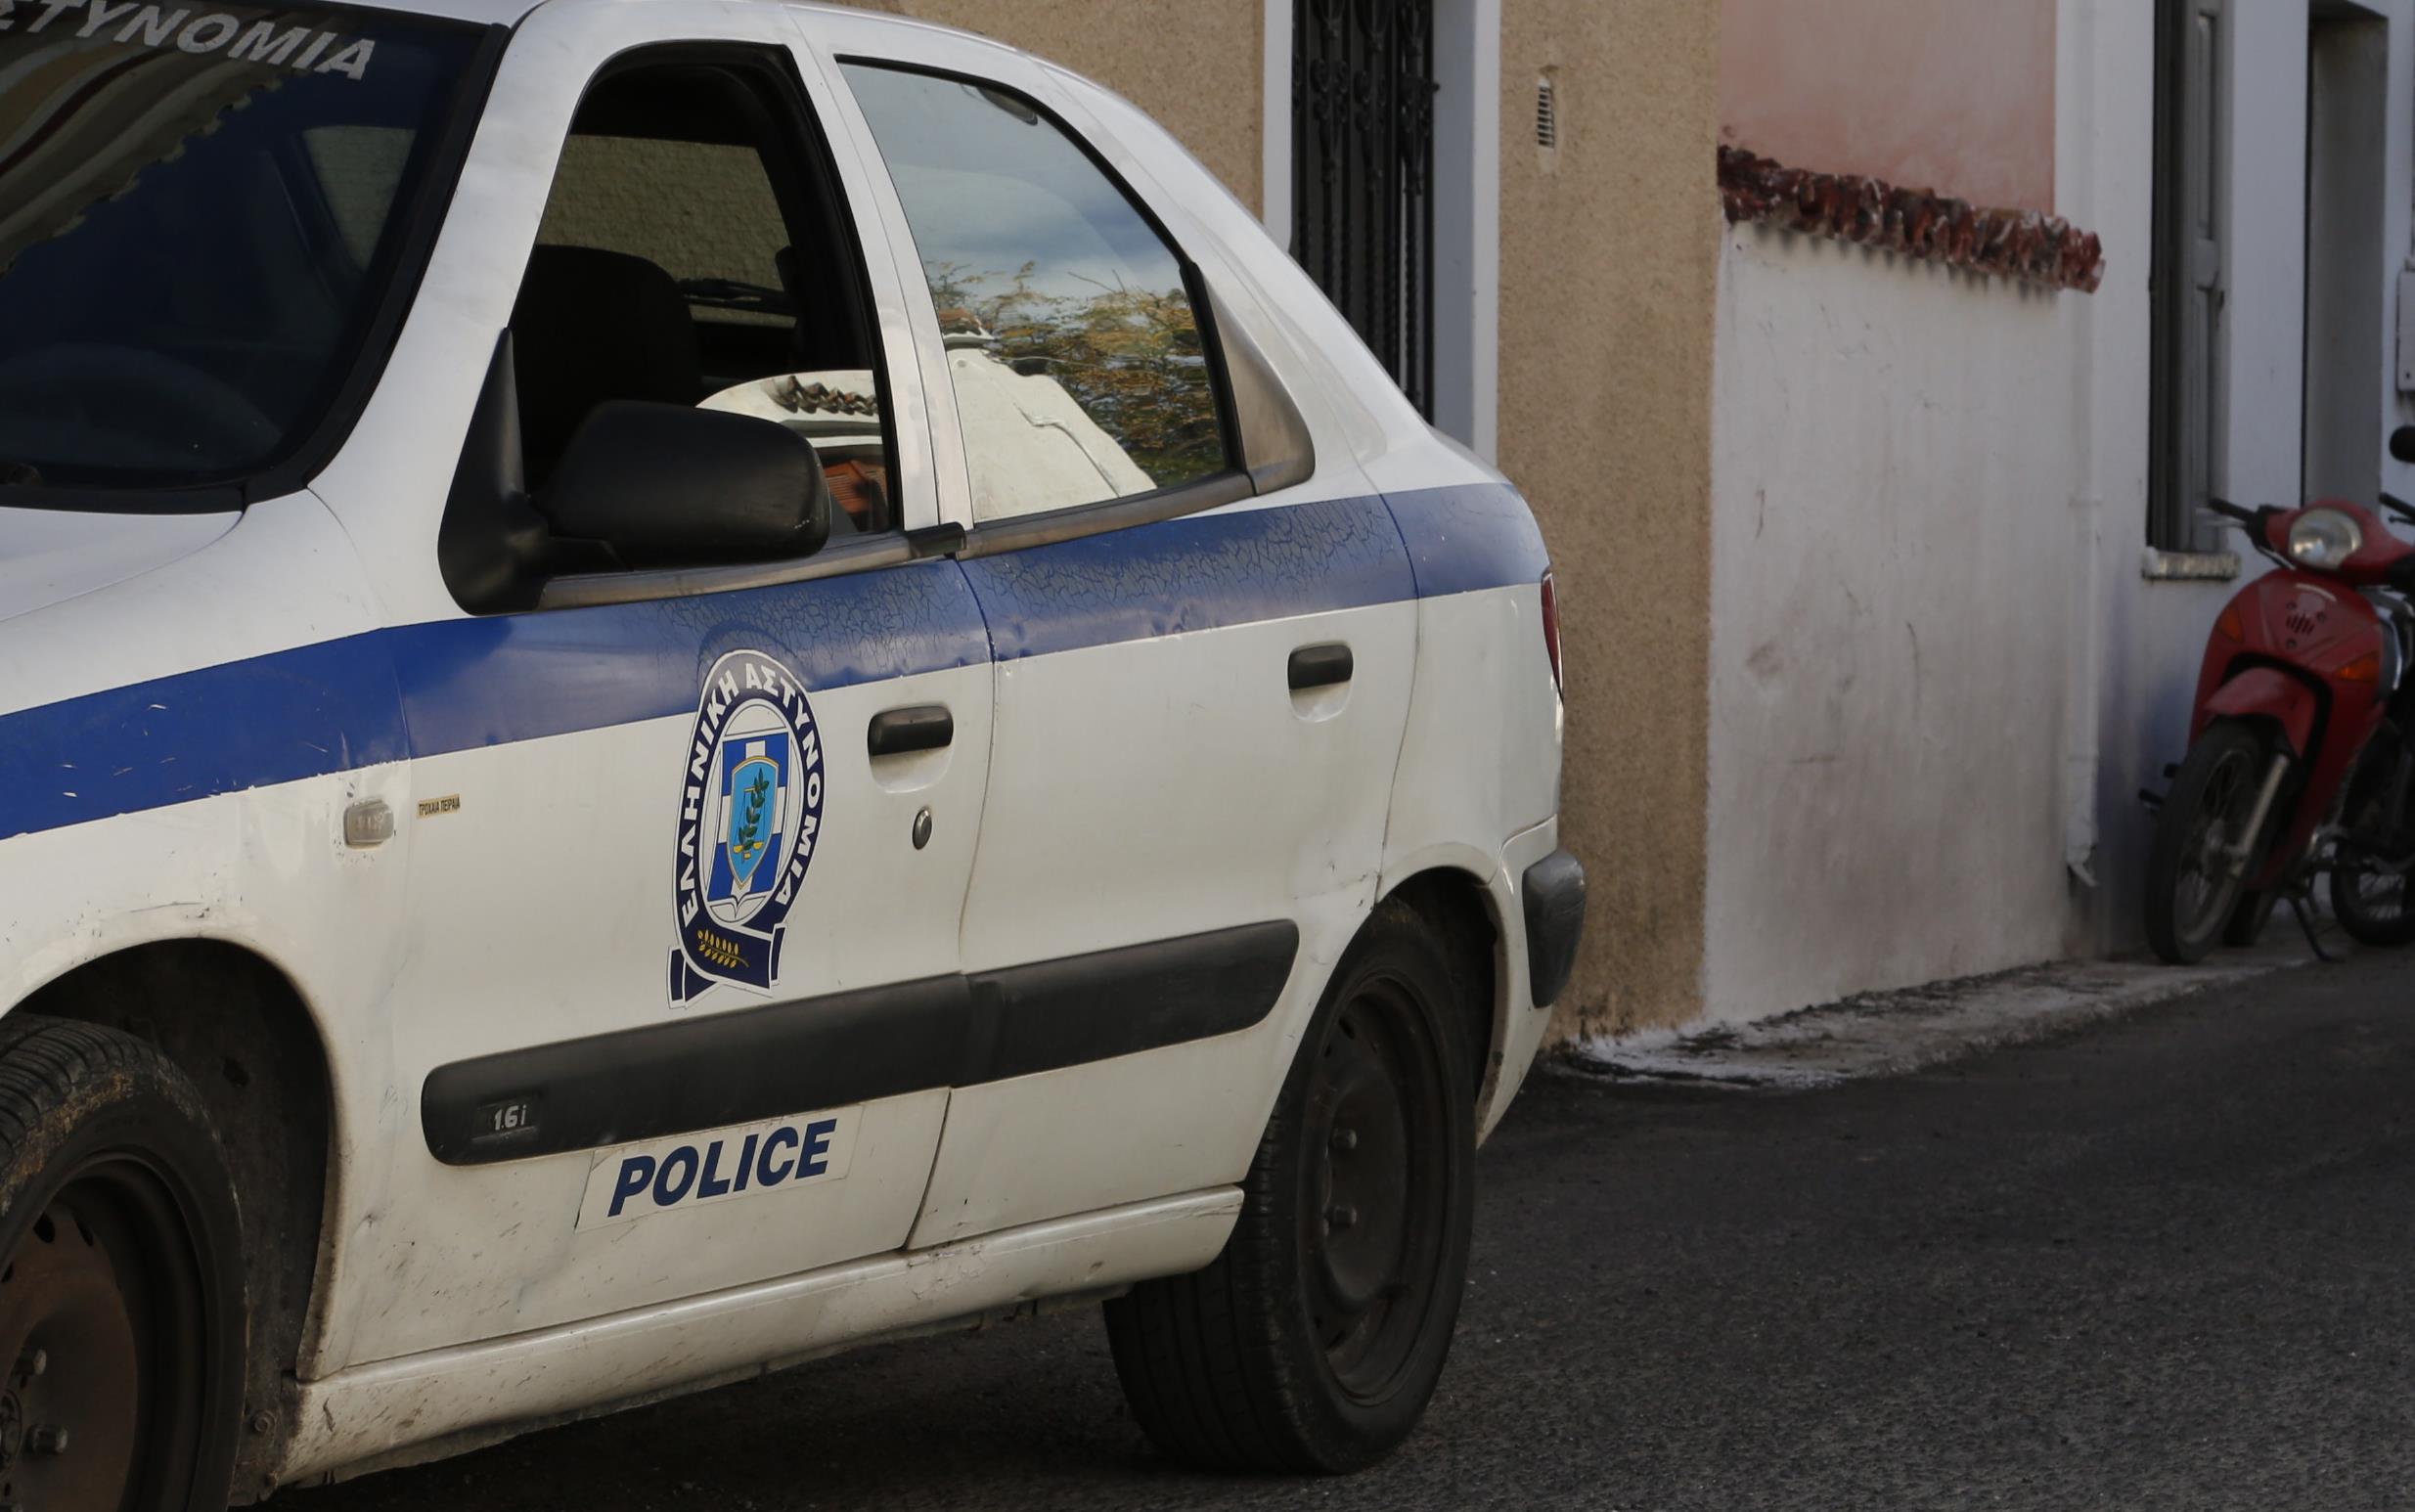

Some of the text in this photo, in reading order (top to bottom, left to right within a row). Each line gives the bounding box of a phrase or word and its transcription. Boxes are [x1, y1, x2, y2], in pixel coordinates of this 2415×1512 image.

[680, 663, 821, 928] ΕΛΛΗΝΙΚΗ ΑΣΤΥΝΟΜΙΑ
[494, 1103, 526, 1131] 1.6i
[607, 1118, 837, 1218] POLICE
